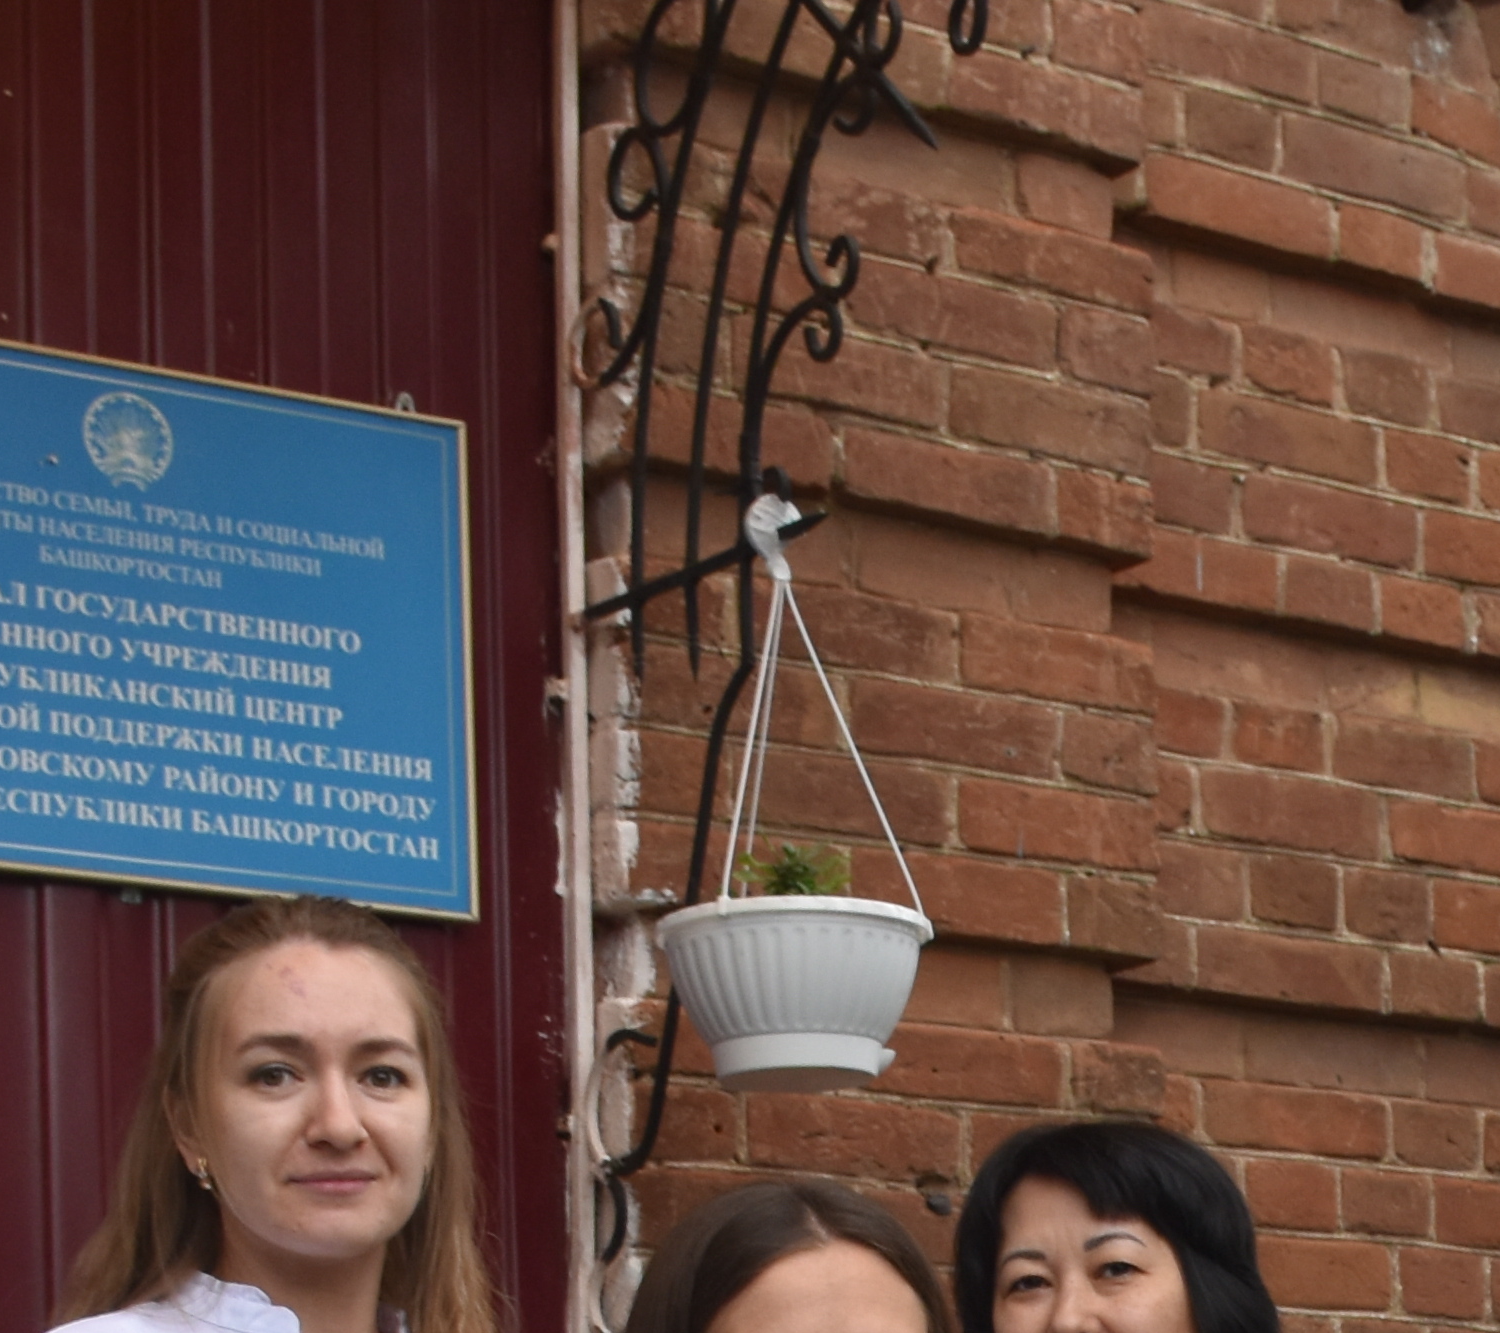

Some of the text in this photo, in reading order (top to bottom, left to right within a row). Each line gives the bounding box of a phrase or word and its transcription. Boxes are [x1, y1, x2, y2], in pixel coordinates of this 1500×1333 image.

[39, 515, 174, 553] НАСЕЛЕНИЯ
[179, 537, 322, 577] РЕСПУБЛИКИ
[142, 503, 211, 533] ТРУДА
[216, 515, 233, 536] И
[236, 519, 385, 560] СОЦИАЛЬНОЙ
[39, 544, 222, 588] БАШКОРТОСТАН
[36, 584, 362, 654] ГОСУДАРСТВЕННОГО
[120, 636, 332, 689] УЧРЕЖДЕНИЯ
[245, 695, 343, 730] ЦЕНТР
[49, 709, 244, 757] ПОДДЕРЖКИ
[252, 735, 433, 782] НАСЕЛЕНИЯ
[162, 765, 285, 802] РАЙОНУ
[293, 781, 314, 807] И
[322, 784, 436, 822] ГОРОДУ
[192, 809, 440, 861] БАШКОРТОСТАН
